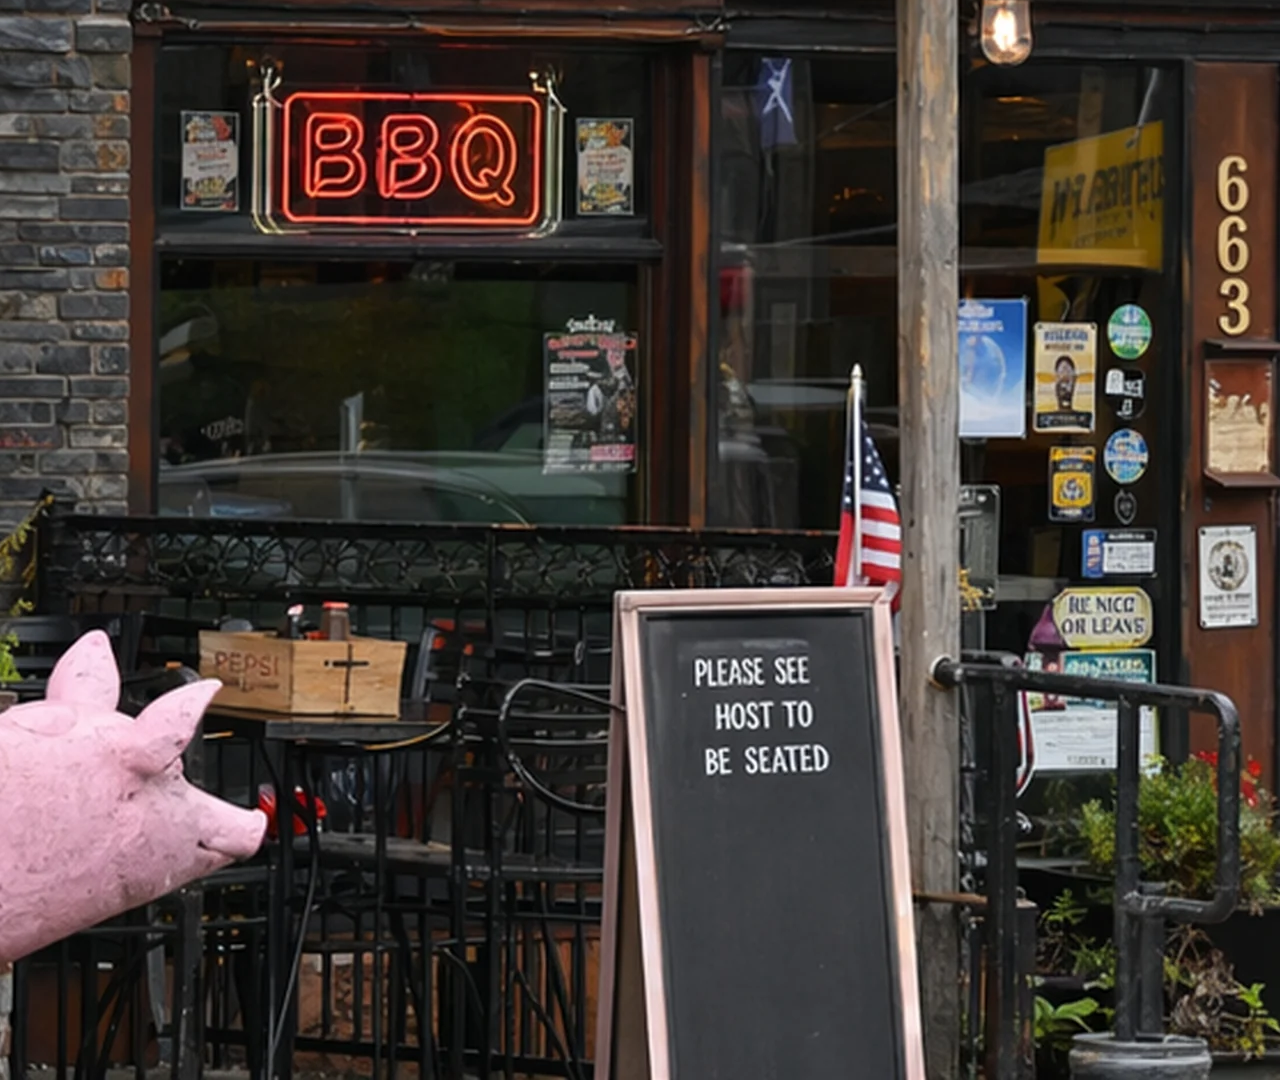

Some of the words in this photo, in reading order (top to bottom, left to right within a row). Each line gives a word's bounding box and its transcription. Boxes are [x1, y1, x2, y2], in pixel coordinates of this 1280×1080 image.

[305, 112, 517, 206] BBQ
[1217, 155, 1251, 336] 663
[1061, 617, 1087, 635] OR
[214, 651, 280, 678] PEPSI
[694, 657, 766, 688] PLEASE
[773, 655, 811, 685] SEE
[714, 701, 775, 731] HOST
[780, 699, 814, 729] TO
[704, 747, 733, 776] BE
[743, 743, 830, 775] SEATED
